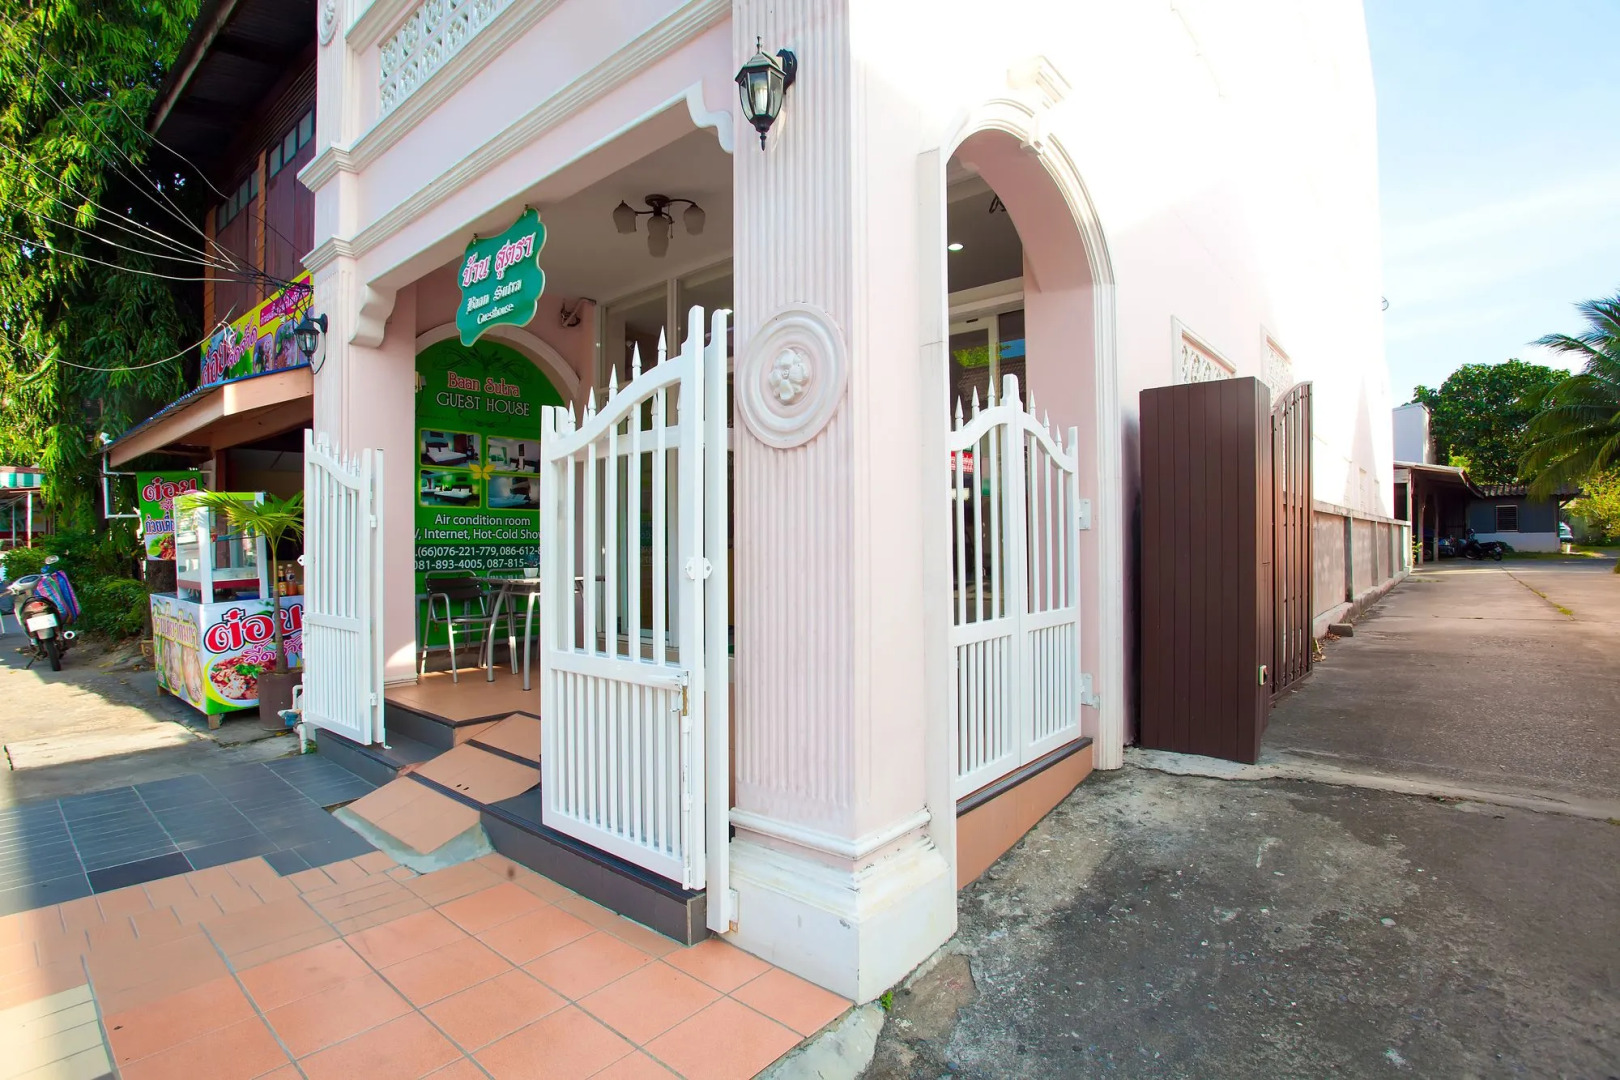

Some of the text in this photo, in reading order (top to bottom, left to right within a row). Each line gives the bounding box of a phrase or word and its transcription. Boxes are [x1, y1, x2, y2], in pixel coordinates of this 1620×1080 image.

[462, 252, 491, 287] บ้าน
[447, 371, 521, 398] Baan Sutra
[436, 391, 530, 416] GUEST HOUSE
[435, 514, 531, 526] Air condition room
[424, 528, 471, 540] Internet,
[473, 529, 518, 539] Hot-Cold
[520, 529, 540, 539] Sho
